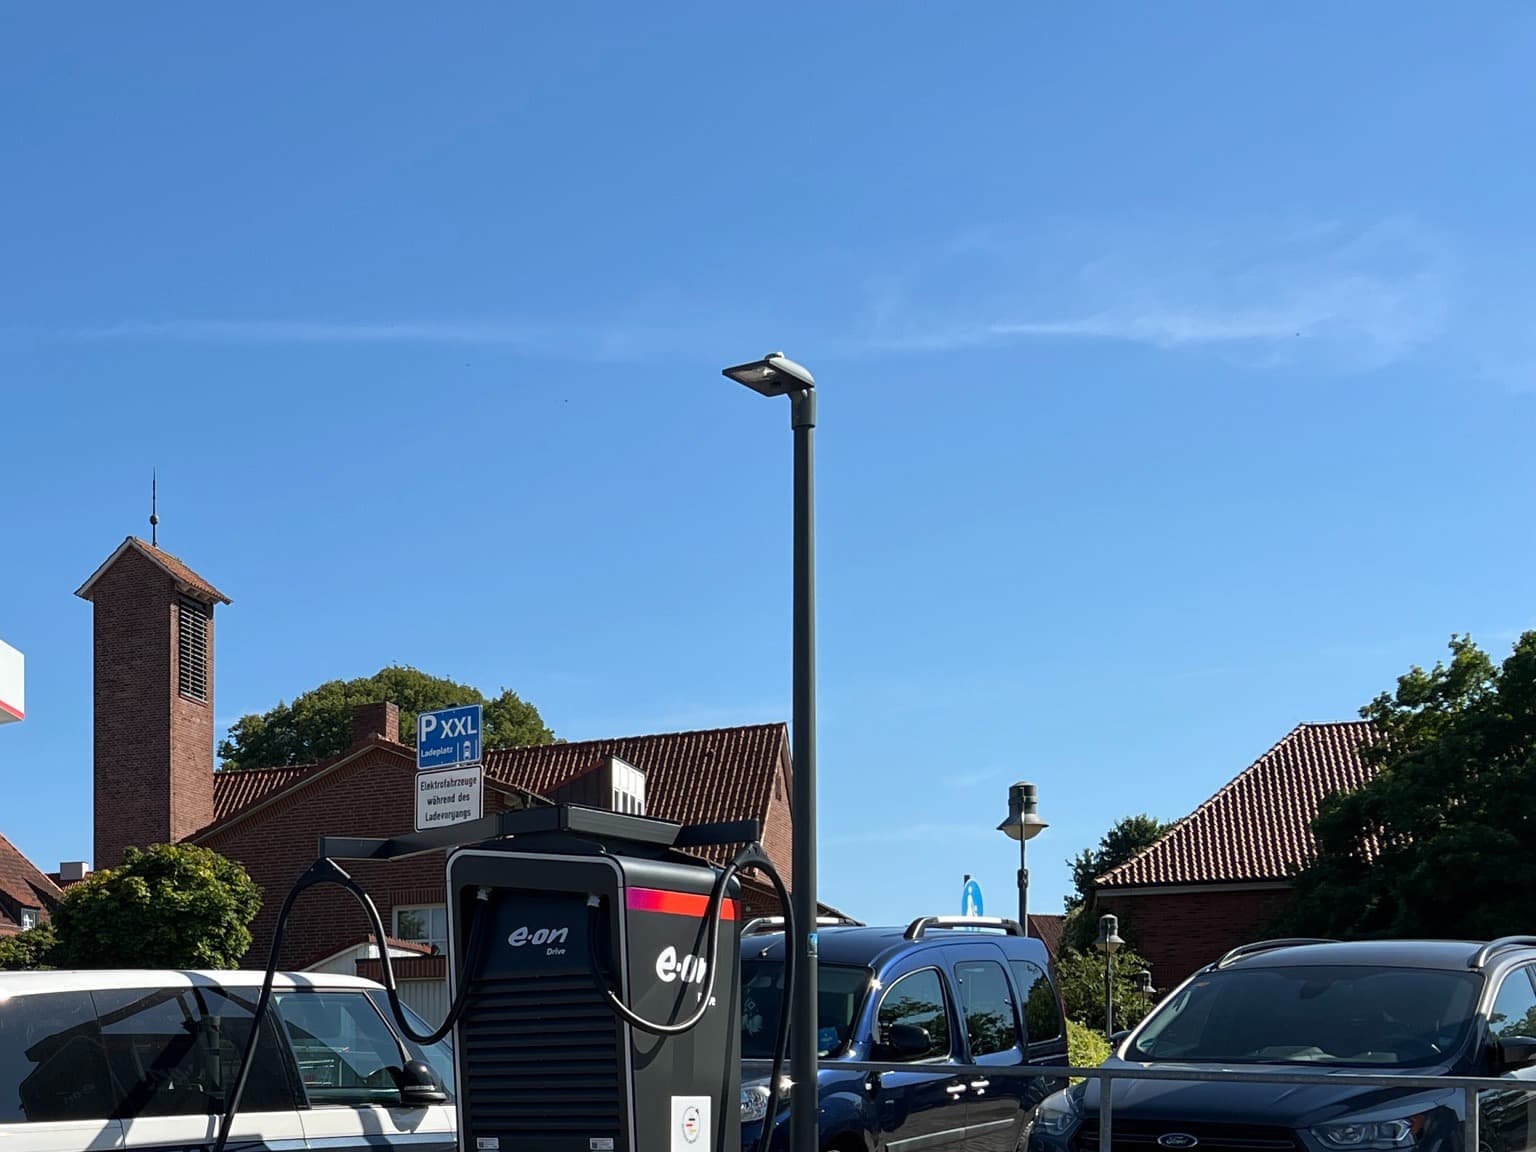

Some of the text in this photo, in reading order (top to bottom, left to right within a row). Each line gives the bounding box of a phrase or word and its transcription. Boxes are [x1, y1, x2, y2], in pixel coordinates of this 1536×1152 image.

[421, 715, 478, 742] P XXL
[421, 746, 454, 758] Ladeplatz
[420, 776, 477, 791] Elektrofahrzeuge
[427, 792, 471, 806] während des
[425, 809, 472, 822] Ladevorgangs
[546, 947, 566, 956] Drive
